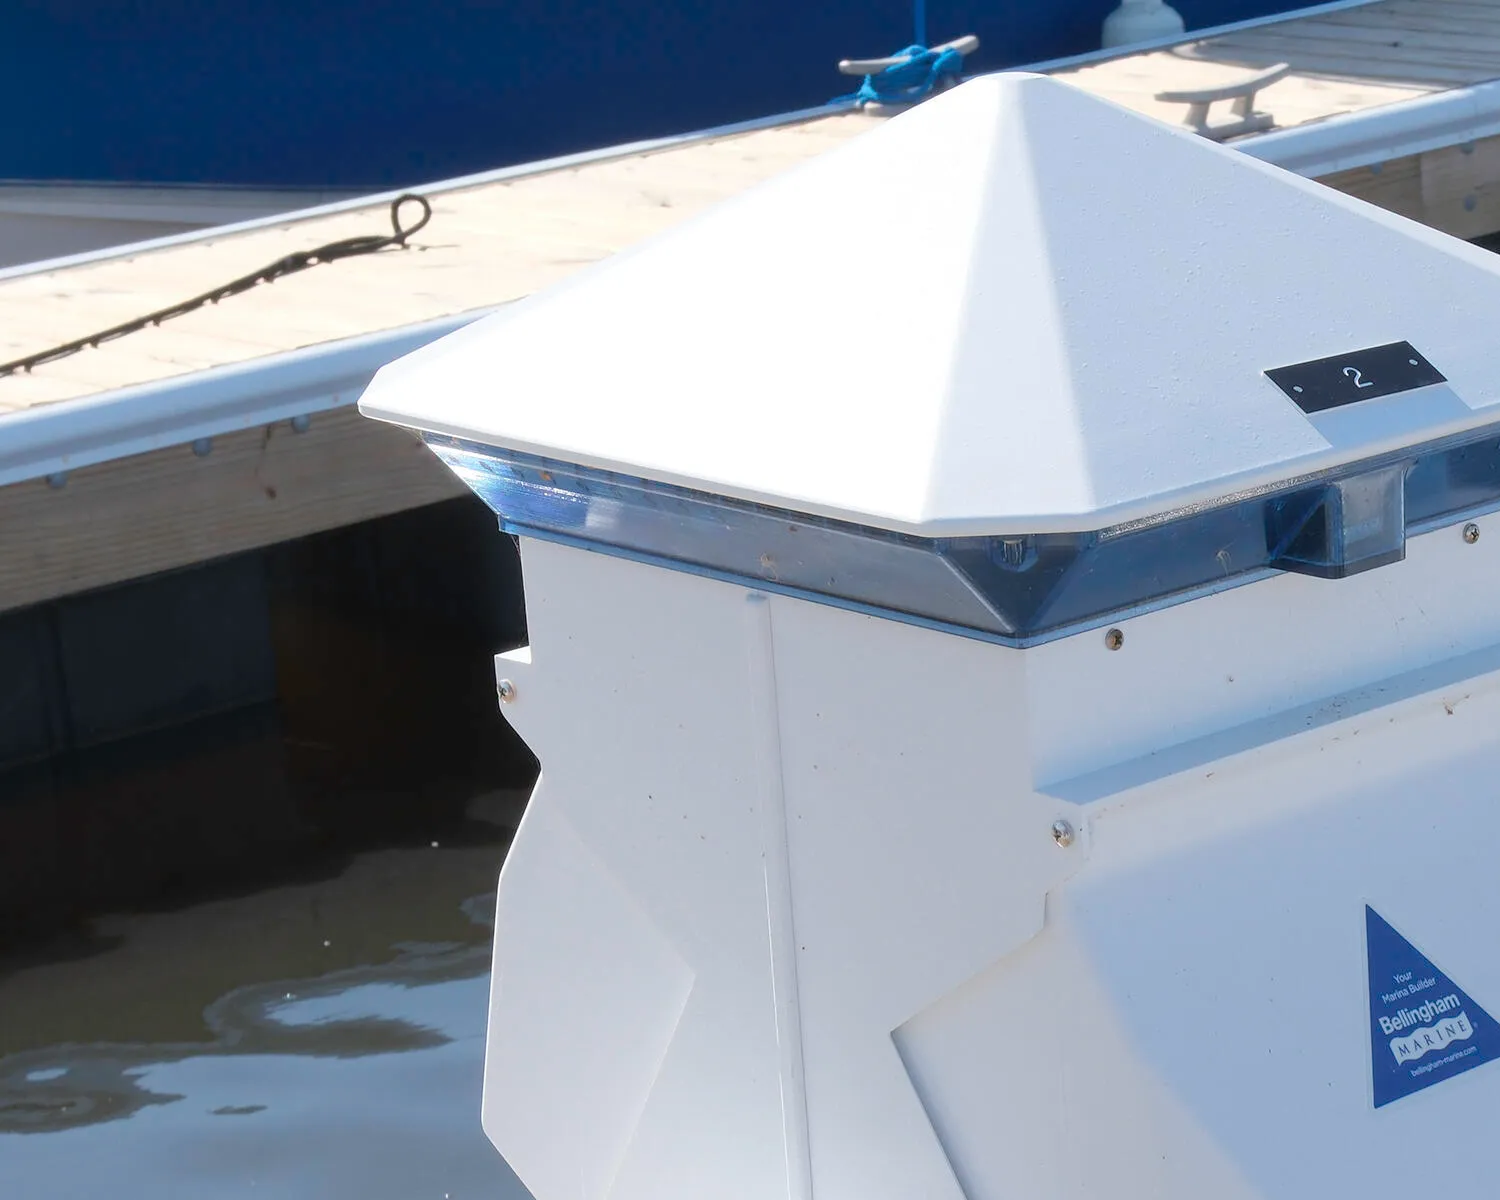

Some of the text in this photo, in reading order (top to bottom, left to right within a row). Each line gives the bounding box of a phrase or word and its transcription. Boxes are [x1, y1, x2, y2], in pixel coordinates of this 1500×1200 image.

[1343, 366, 1374, 388] 2
[1382, 977, 1436, 1004] Marina Builder
[1393, 971, 1412, 984] Your
[1378, 993, 1460, 1035] Bellingham
[1398, 1019, 1466, 1057] MARINE
